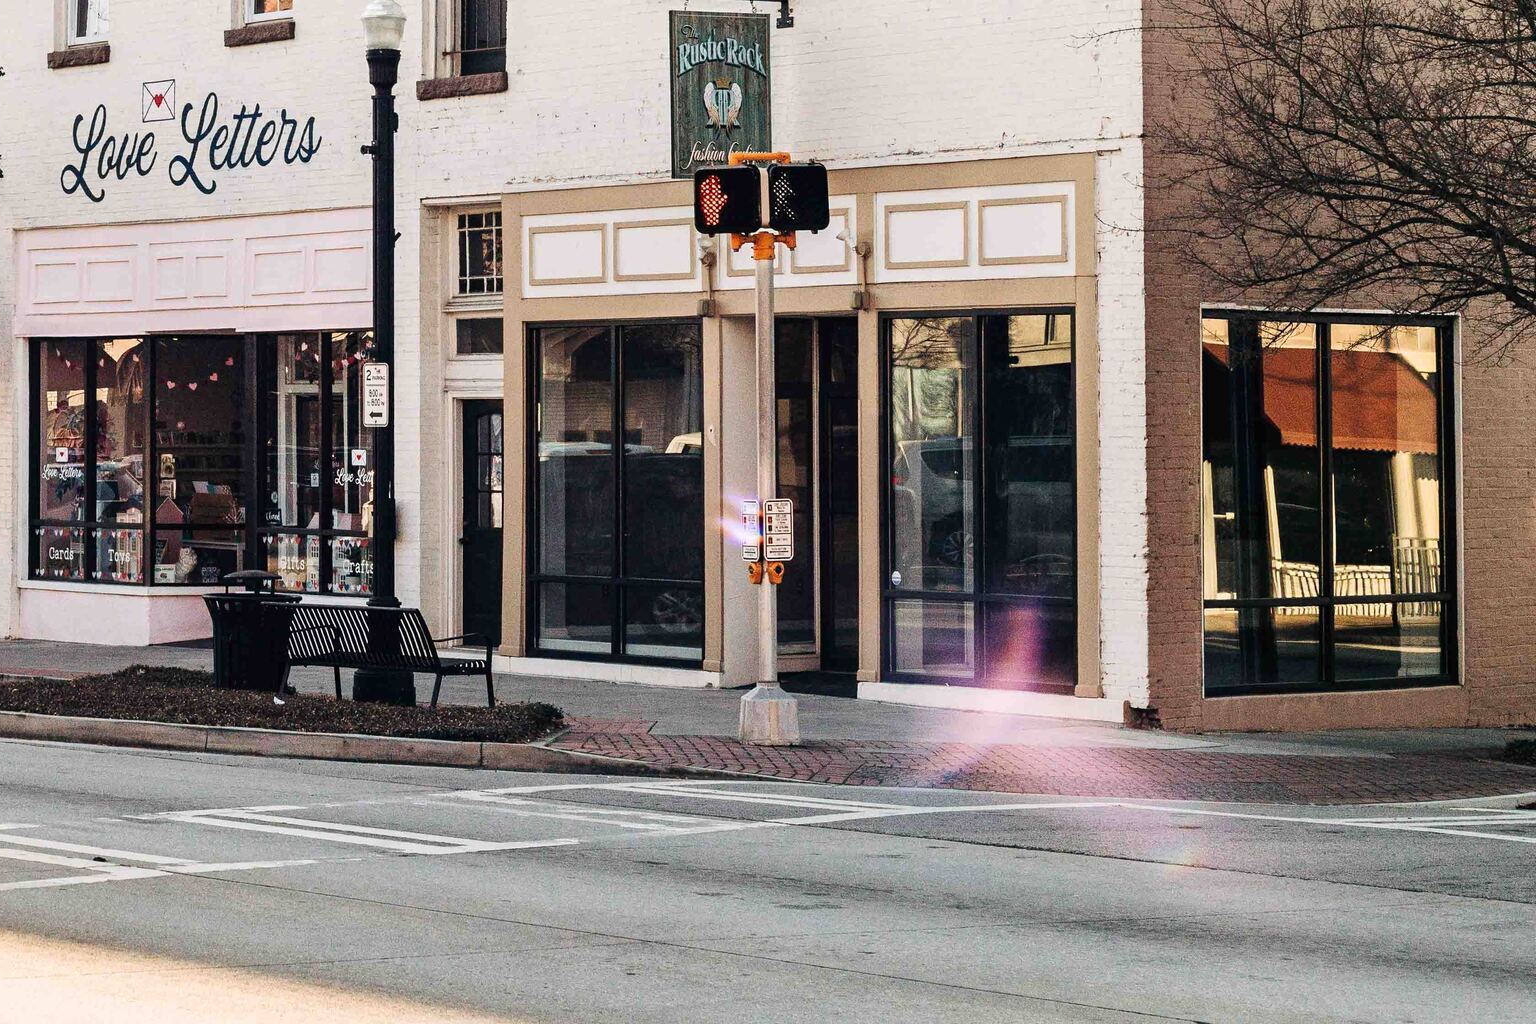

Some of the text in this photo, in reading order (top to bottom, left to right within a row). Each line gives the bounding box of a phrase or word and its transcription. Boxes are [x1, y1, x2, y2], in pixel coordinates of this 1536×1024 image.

[677, 37, 767, 78] Rustic Rack
[61, 92, 323, 203] Love Letters
[681, 140, 726, 170] fashion
[366, 369, 372, 381] 2
[42, 464, 82, 481] Love Letters
[335, 467, 354, 486] Love
[49, 546, 74, 560] Cards
[108, 549, 131, 566] Toys
[279, 556, 305, 570] Gifts
[342, 558, 374, 575] Crafts
